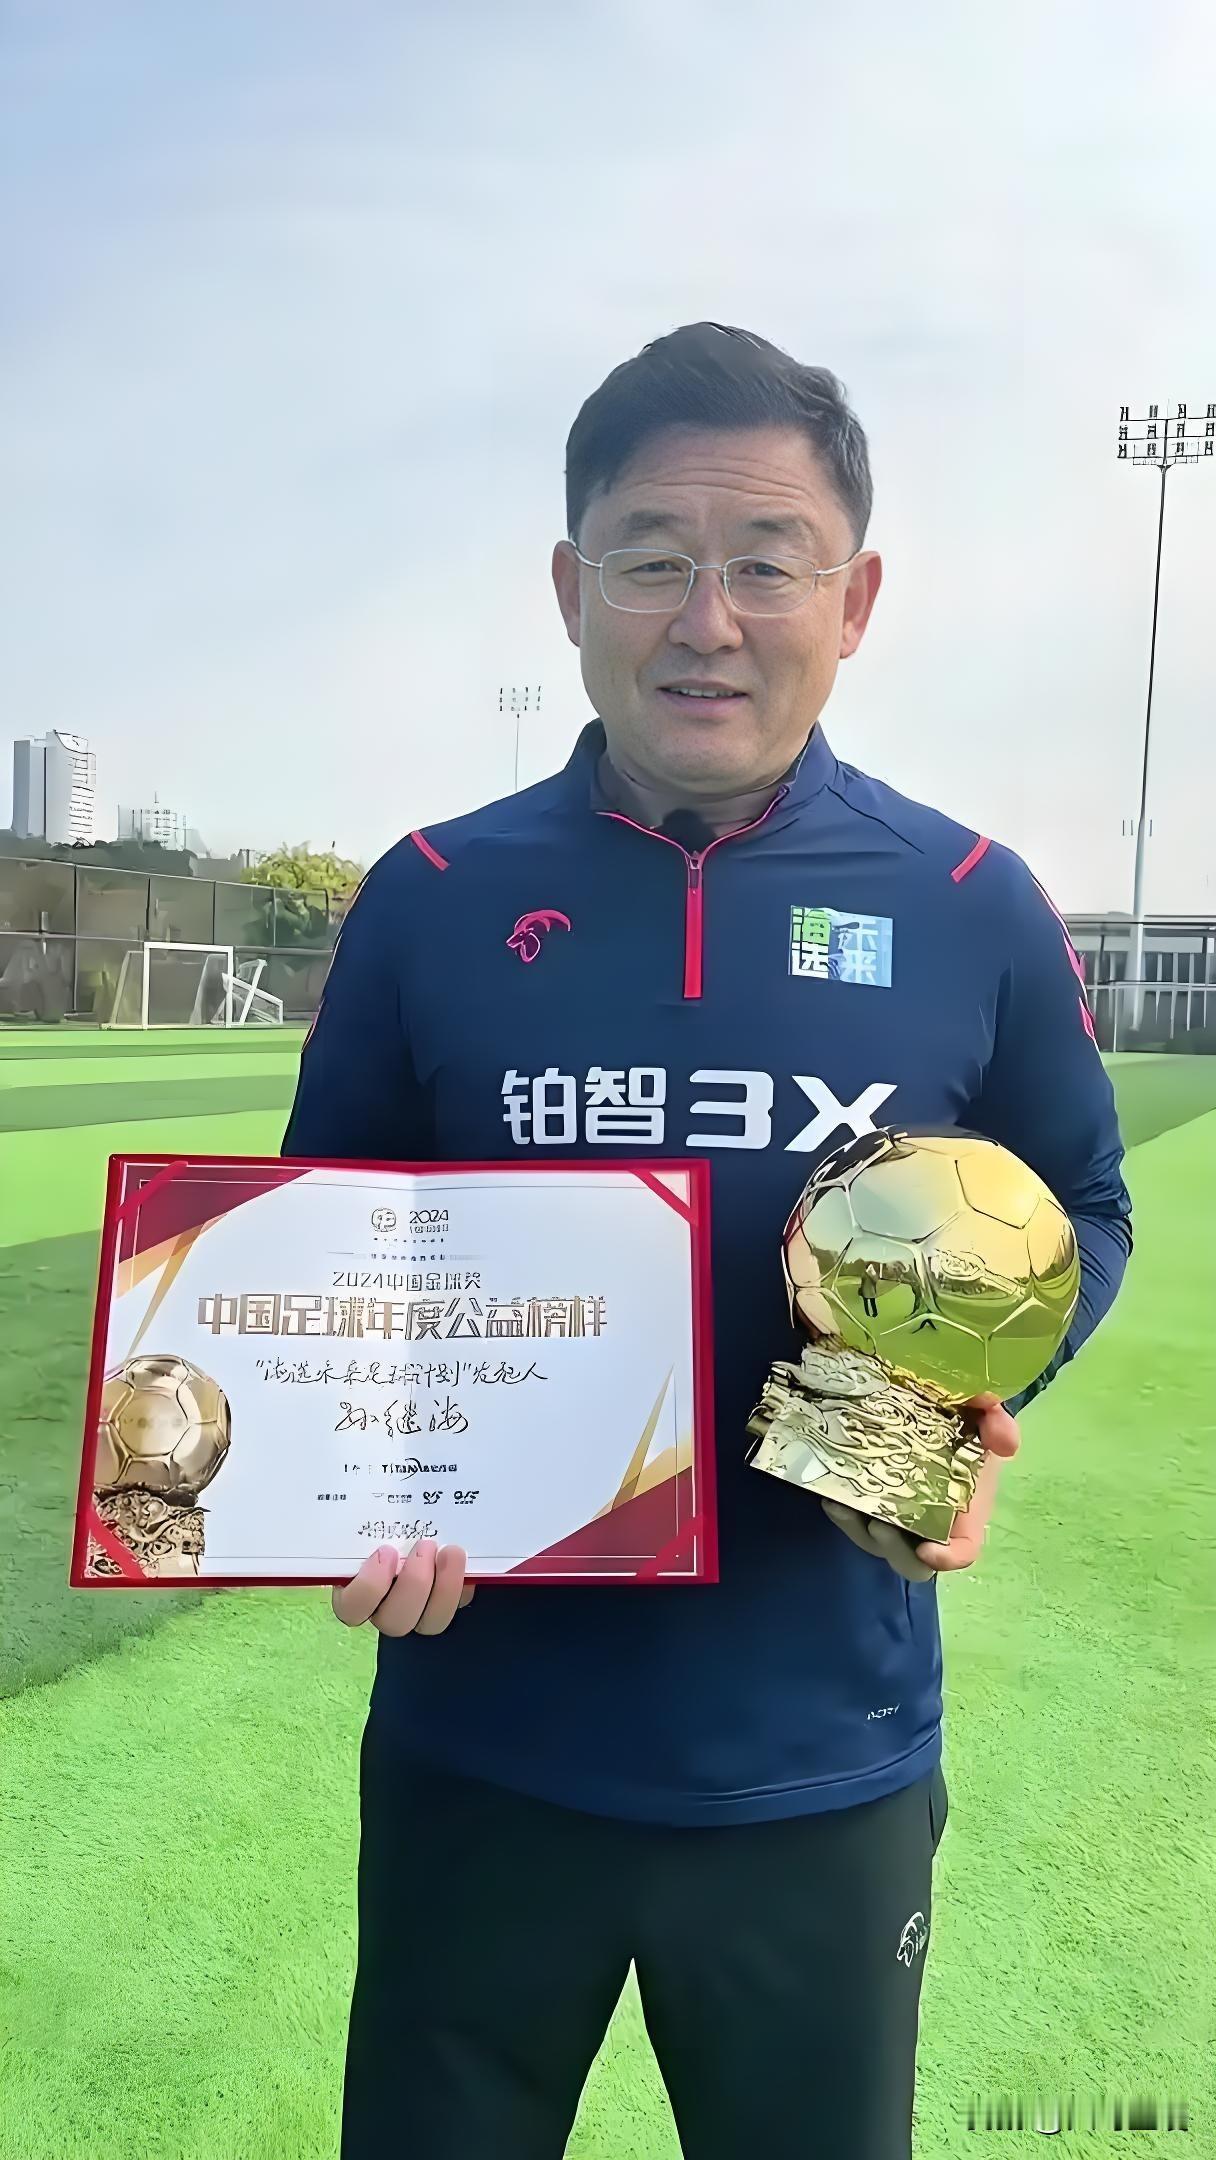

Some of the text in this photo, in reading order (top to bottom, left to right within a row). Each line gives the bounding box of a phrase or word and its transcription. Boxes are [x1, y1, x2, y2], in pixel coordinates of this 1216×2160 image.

[501, 1066, 898, 1153] 铂智3X
[197, 1293, 608, 1340] 中国足球年度公益榜样
[334, 1396, 469, 1439] 孙继海
